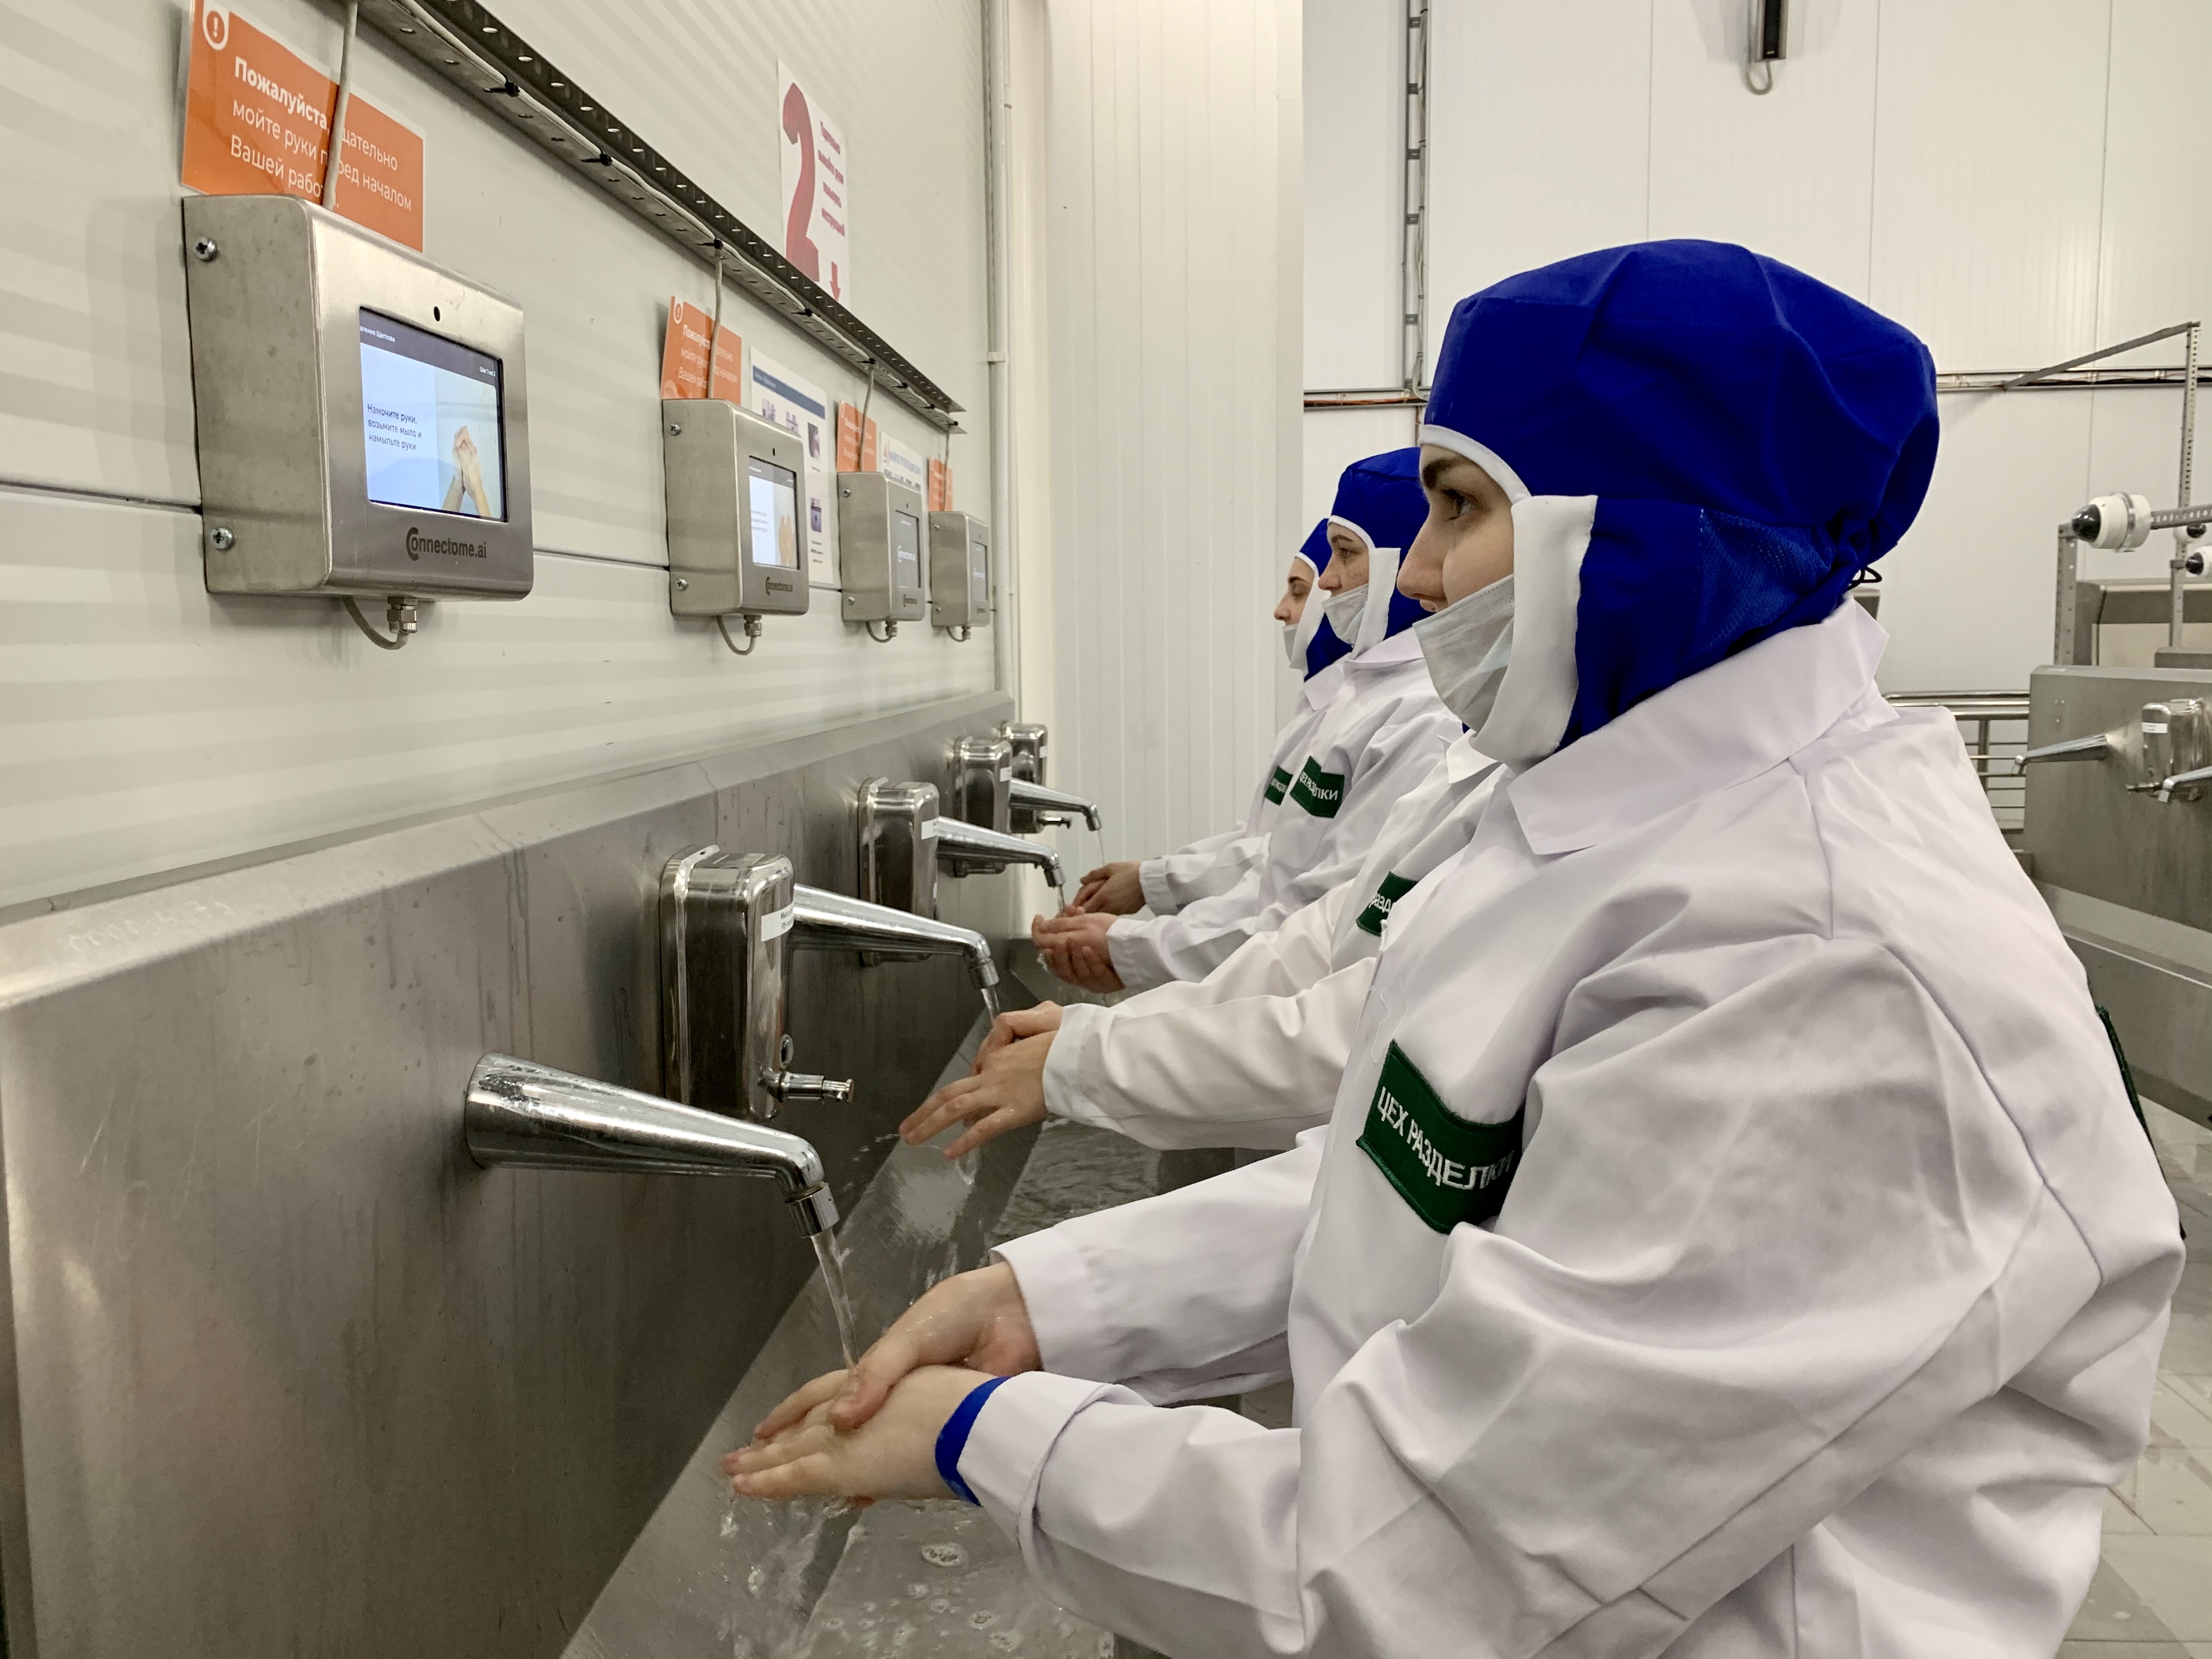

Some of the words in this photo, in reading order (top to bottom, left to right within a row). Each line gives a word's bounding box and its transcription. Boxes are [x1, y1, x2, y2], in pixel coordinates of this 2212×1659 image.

[235, 55, 330, 136] Пожалуйста,
[342, 127, 398, 171] щательно
[231, 134, 284, 180] Вашей
[288, 168, 339, 208] рабо.
[233, 99, 281, 139] мойте
[285, 128, 317, 160] руки
[320, 149, 360, 188] пред
[363, 173, 411, 212] началом
[782, 82, 820, 283] 2
[367, 403, 399, 420] Намочите
[400, 413, 417, 426] руки,
[368, 419, 398, 433] возьмите
[400, 427, 417, 437] мыло
[369, 434, 400, 447] намыльте
[402, 441, 416, 451] руки
[406, 527, 487, 561] Connectome.ai
[1376, 1086, 1409, 1137] ЦЕХ
[1406, 1118, 1515, 1190] РАЗДЕЛКИ
